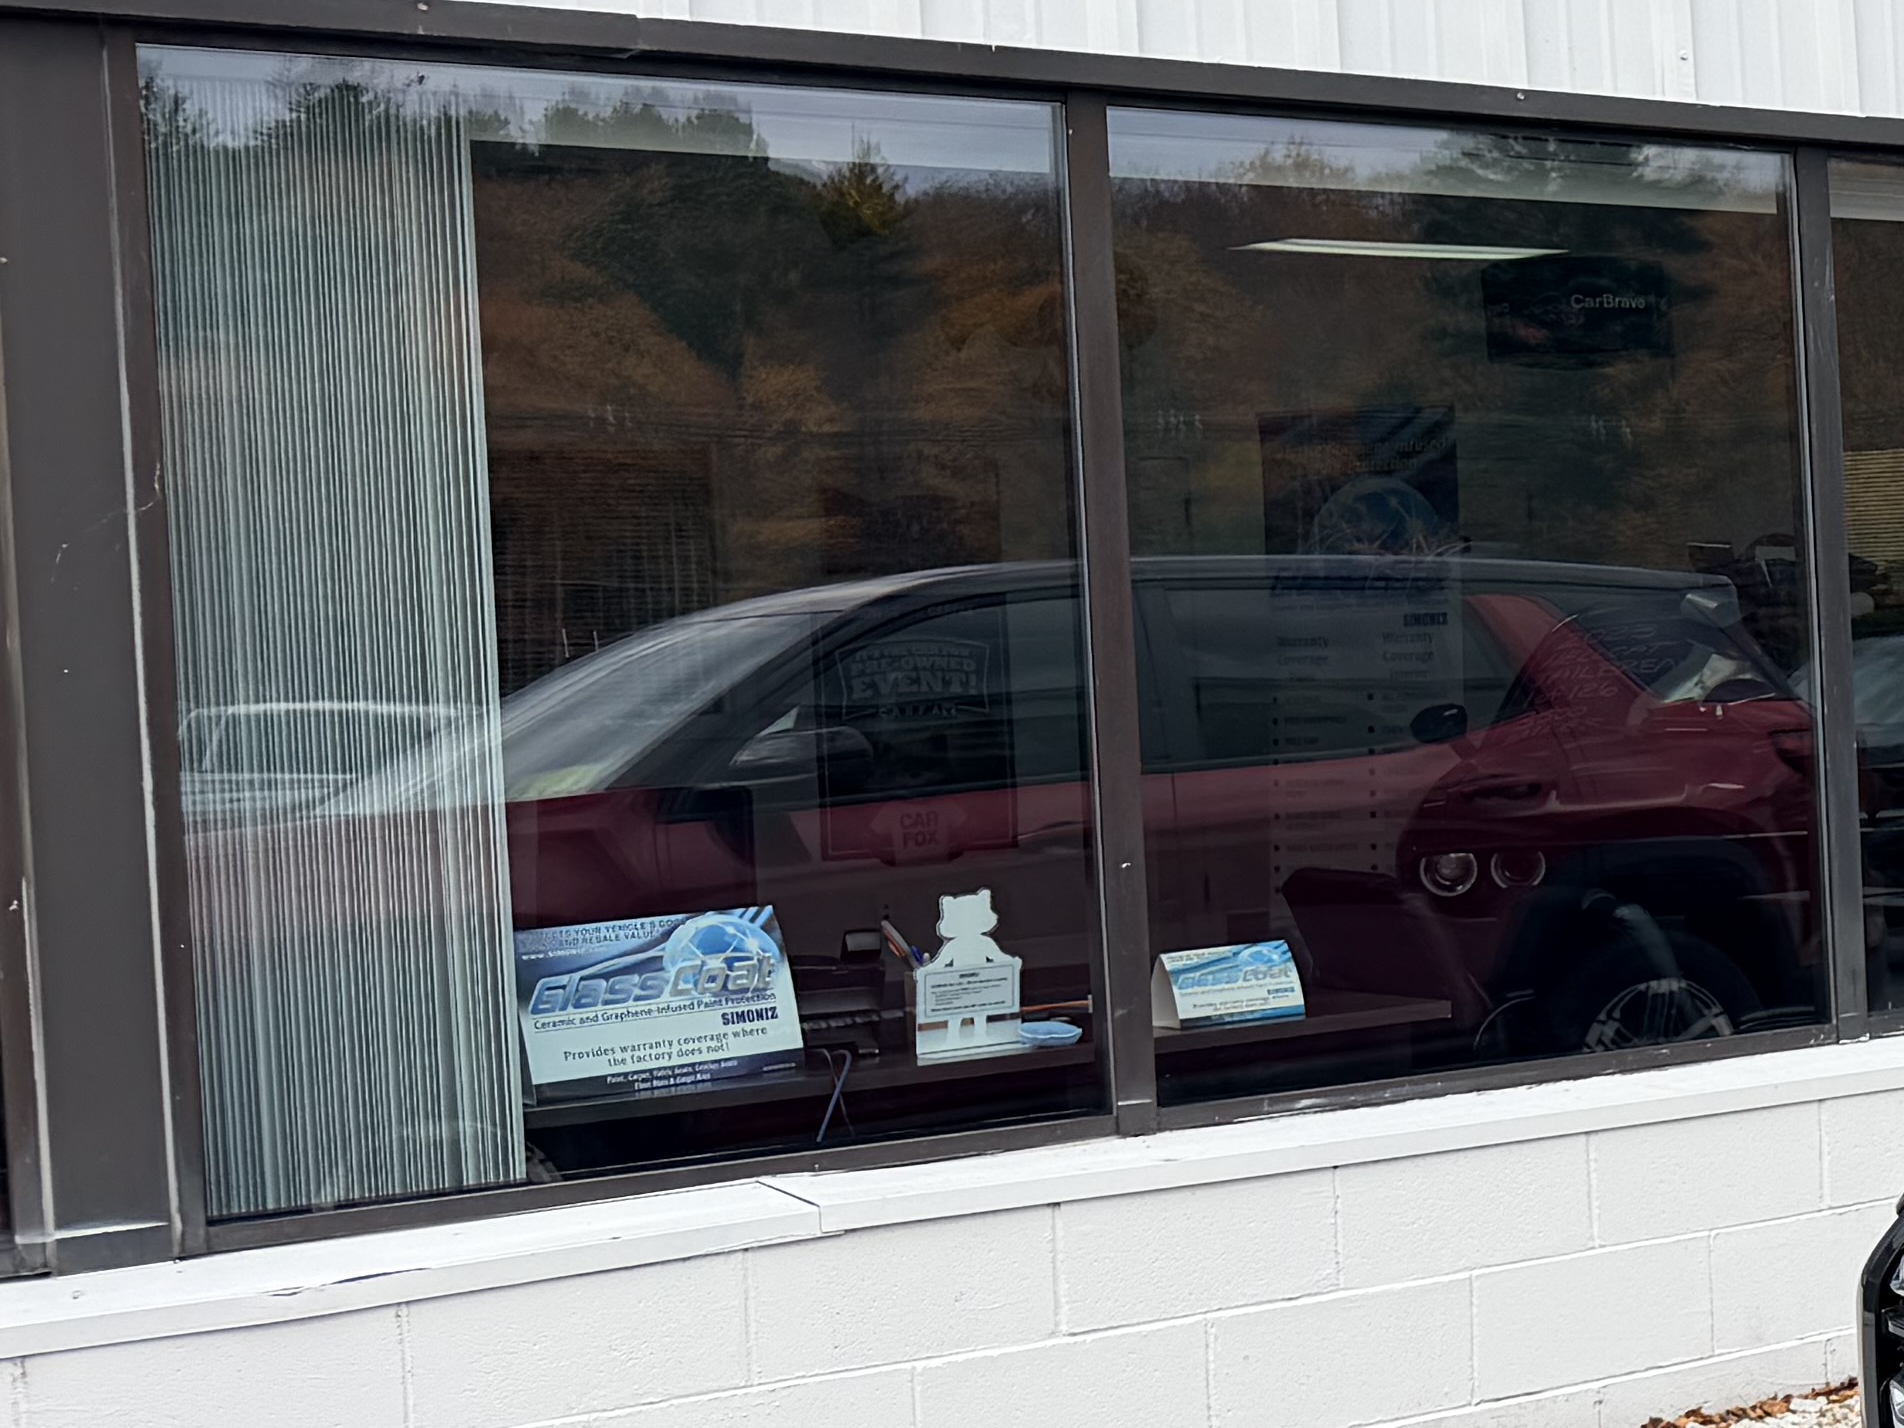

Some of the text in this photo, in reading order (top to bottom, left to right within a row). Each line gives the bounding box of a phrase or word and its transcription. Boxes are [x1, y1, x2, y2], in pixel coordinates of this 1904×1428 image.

[851, 672, 978, 700] EVENT!
[902, 829, 938, 849] FOX
[529, 952, 776, 1015] GlassCoat
[533, 1017, 576, 1031] Ceramic
[579, 1013, 599, 1025] and
[724, 992, 777, 1006] Protection
[721, 1006, 779, 1026] SIMONIZ
[563, 1026, 768, 1062] Provides warranty coverage where
[607, 1056, 627, 1068] the
[630, 1049, 673, 1065] factory
[676, 1045, 704, 1058] does
